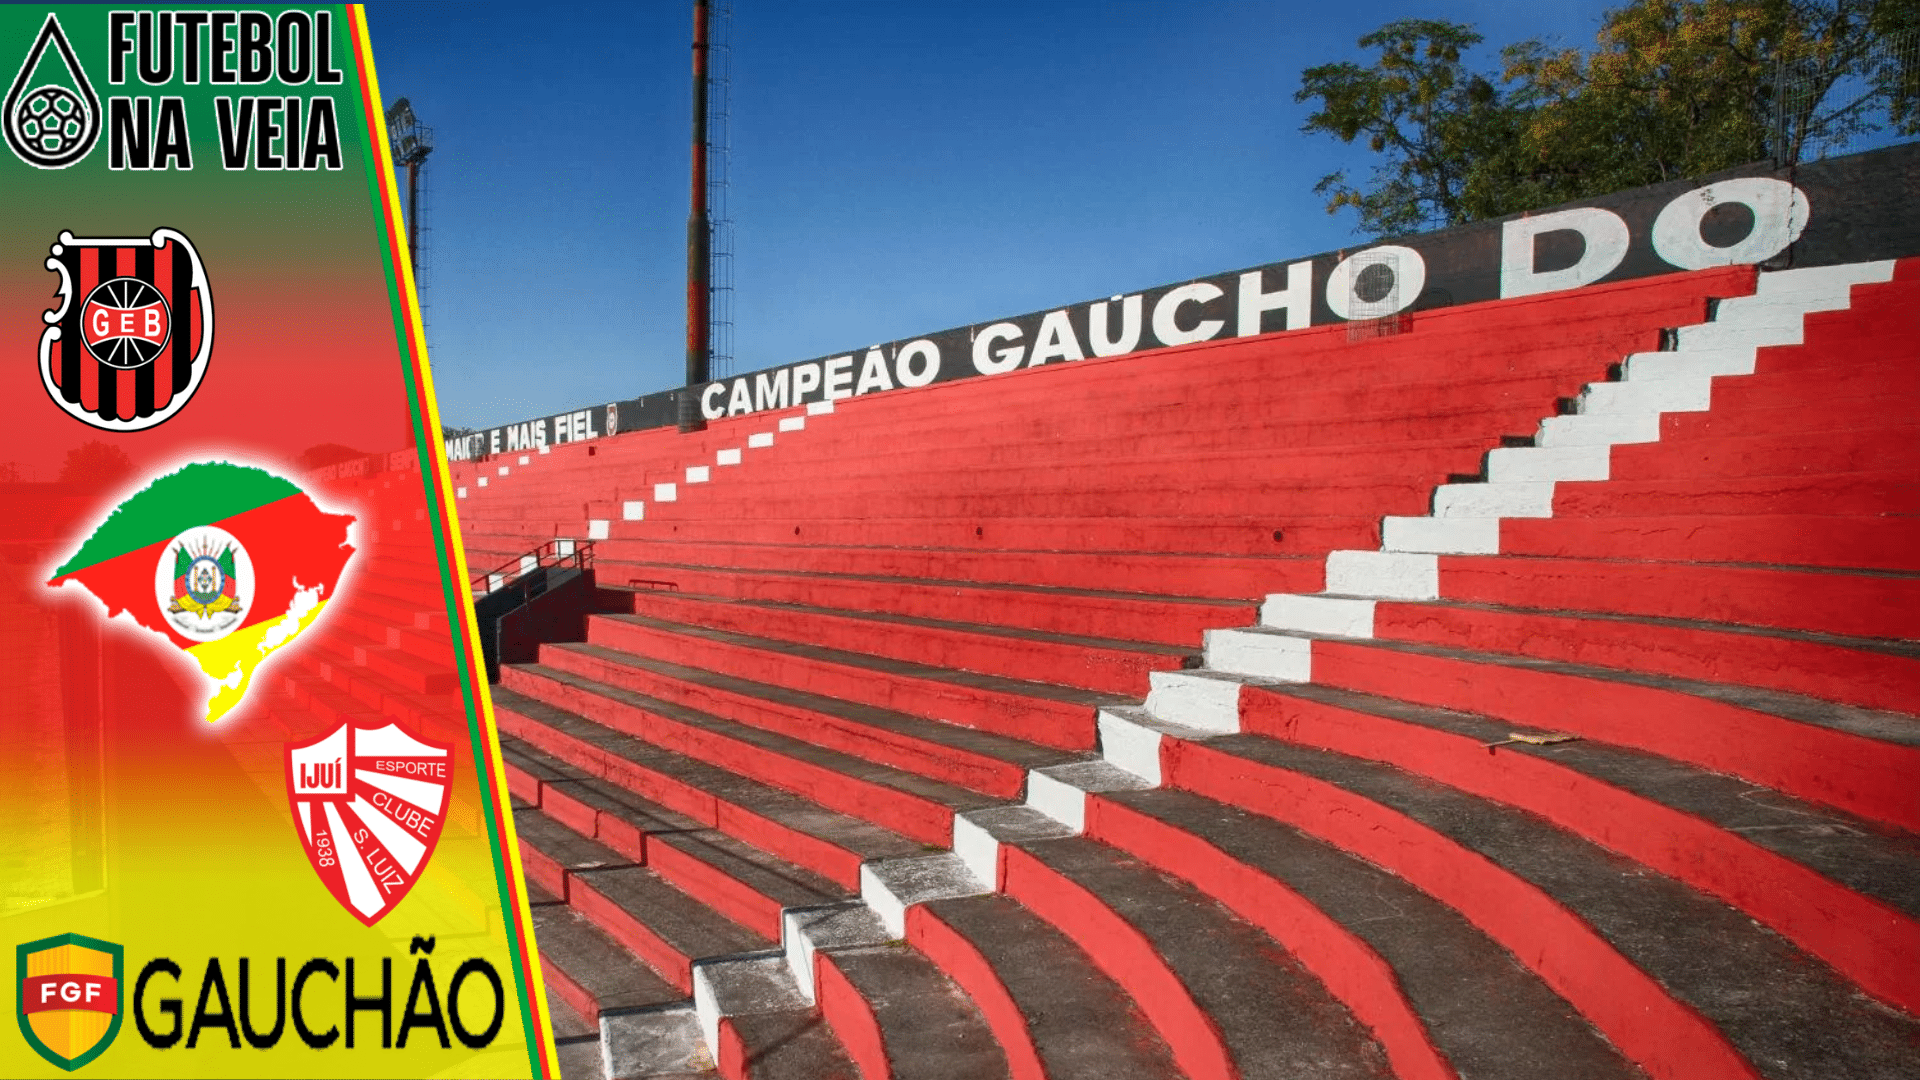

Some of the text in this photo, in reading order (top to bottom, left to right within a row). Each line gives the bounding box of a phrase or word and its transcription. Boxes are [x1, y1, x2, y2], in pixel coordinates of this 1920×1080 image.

[701, 177, 1810, 419] CAMPEÃO GAÚCHO DO
[490, 429, 500, 455] E
[507, 420, 546, 452] MAIS
[555, 410, 598, 444] FIEL
